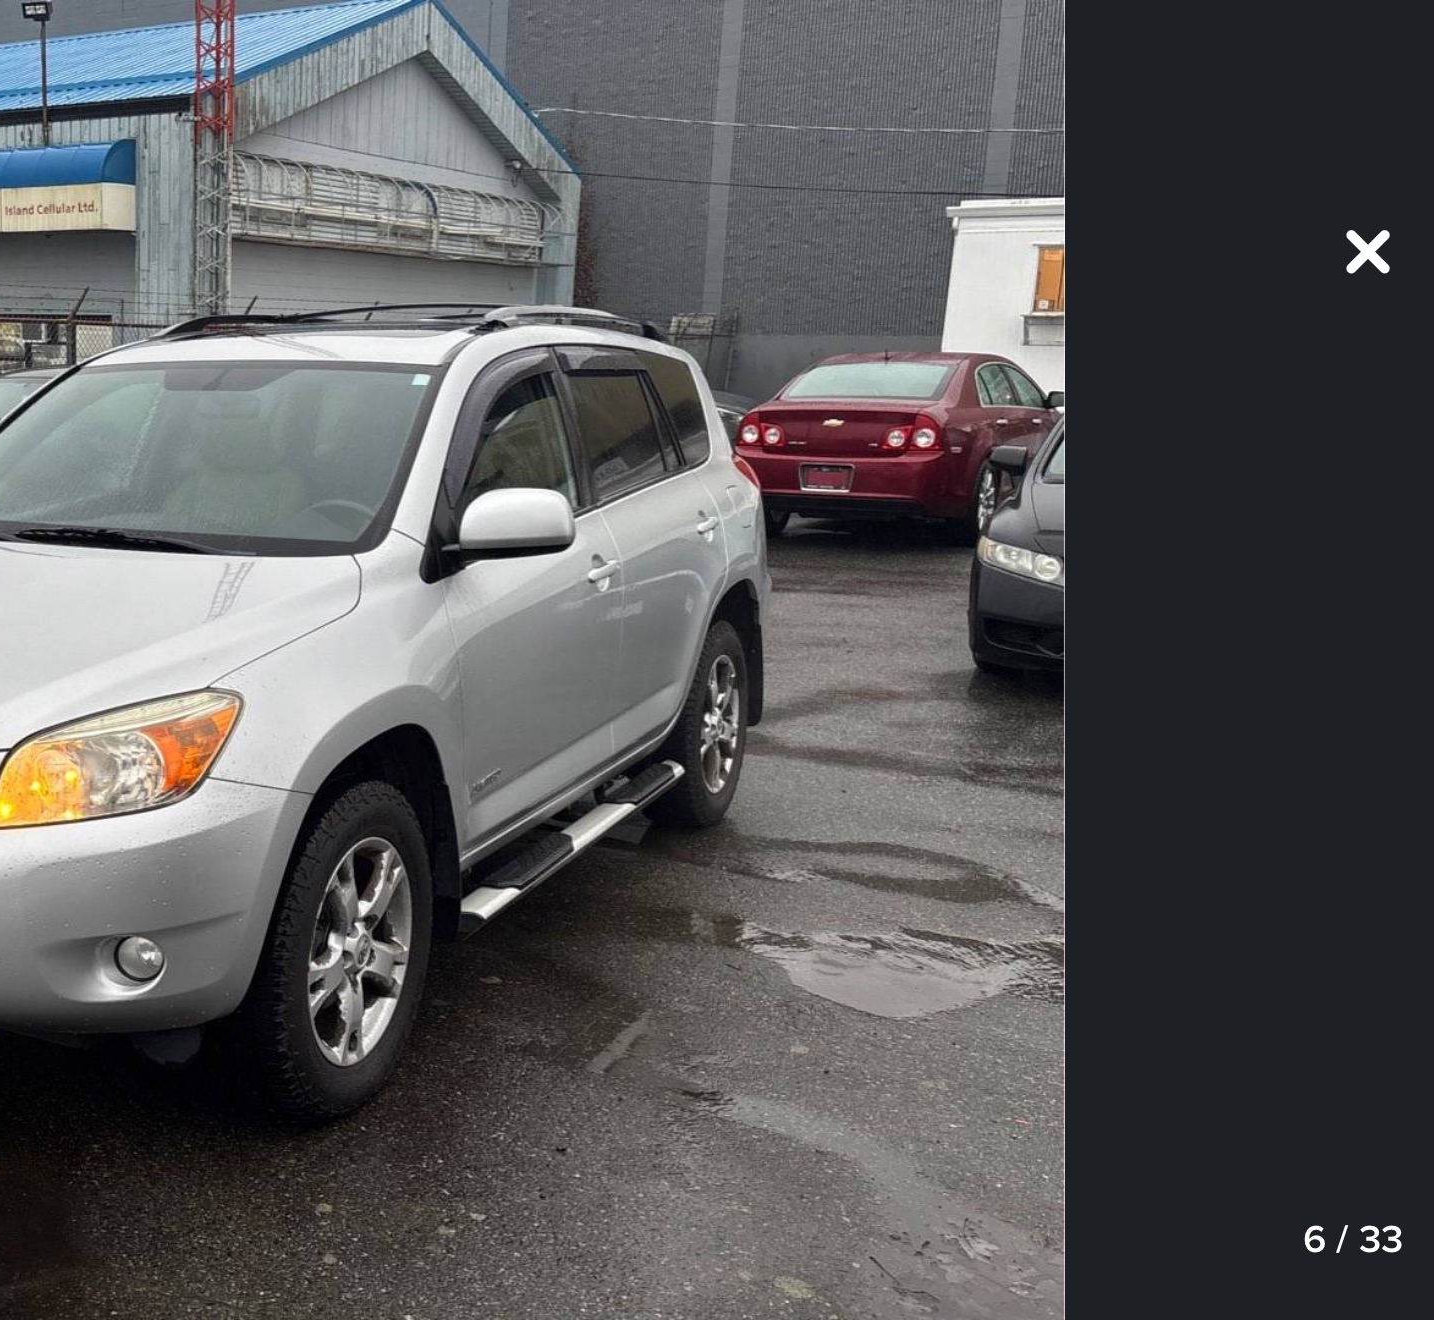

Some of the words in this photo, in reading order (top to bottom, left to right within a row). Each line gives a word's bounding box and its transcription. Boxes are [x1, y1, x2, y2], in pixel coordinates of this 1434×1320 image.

[4, 204, 35, 216] Island
[36, 203, 76, 215] Cellular
[77, 201, 99, 213] Ltd.
